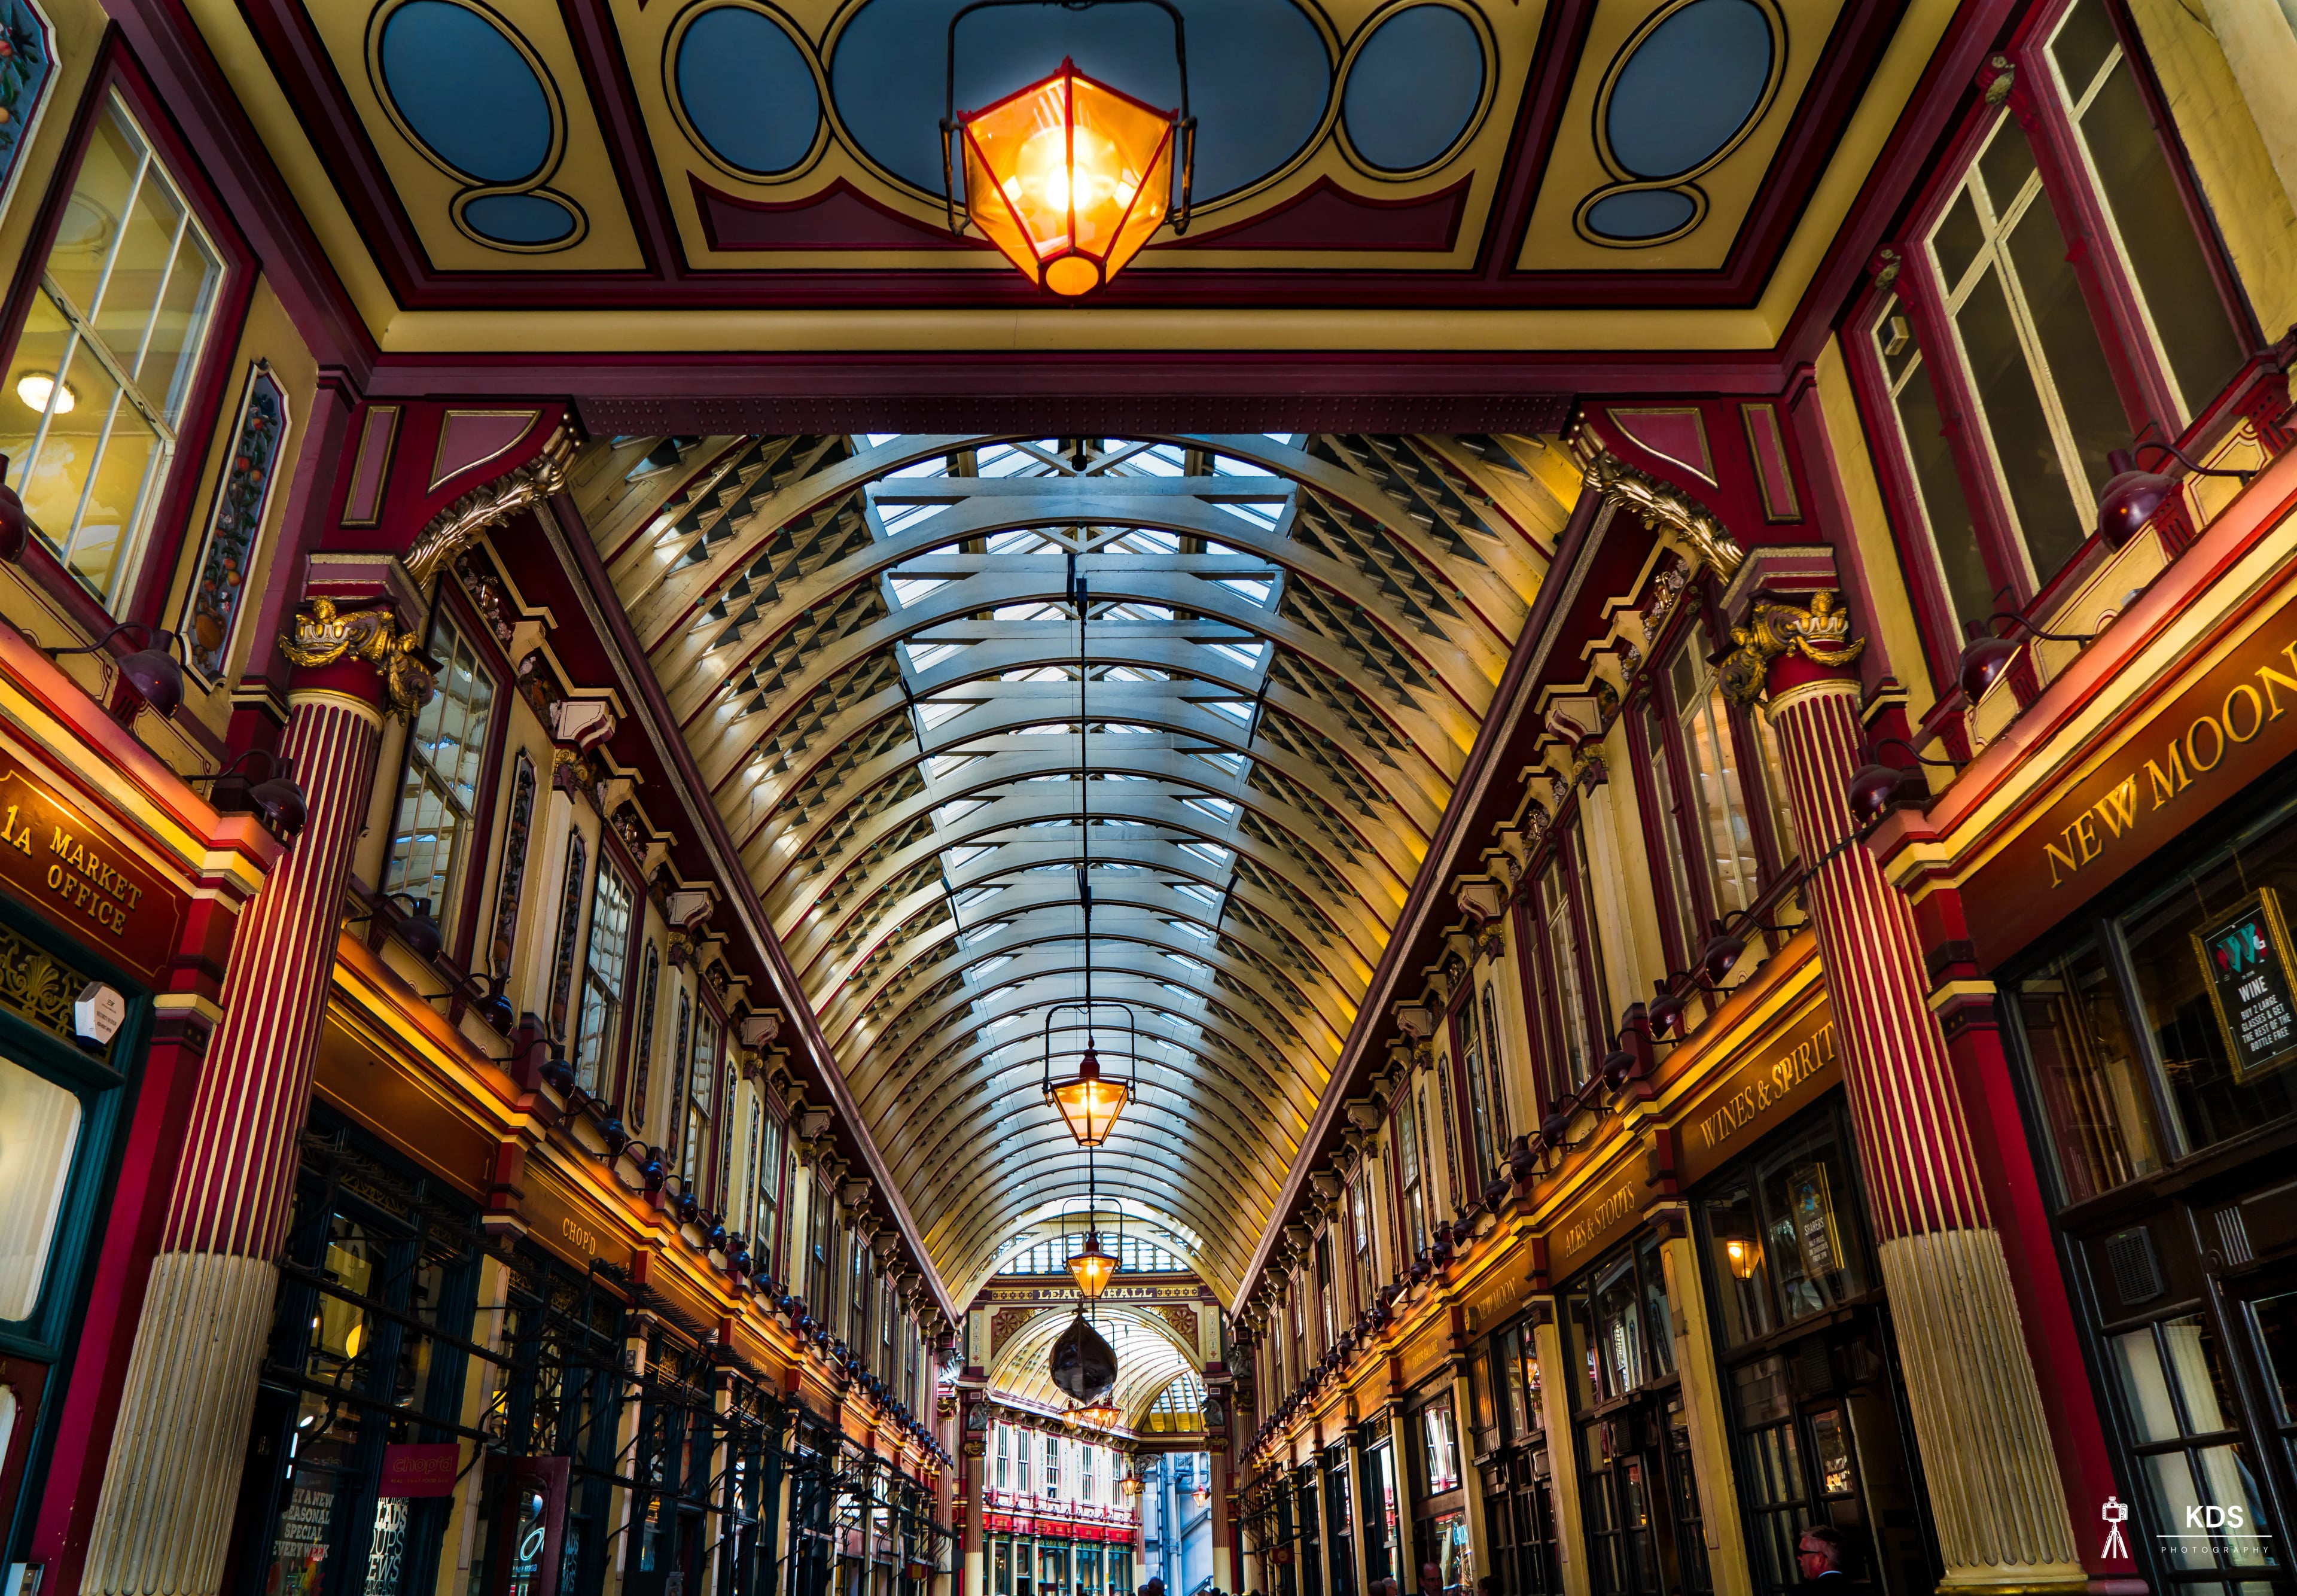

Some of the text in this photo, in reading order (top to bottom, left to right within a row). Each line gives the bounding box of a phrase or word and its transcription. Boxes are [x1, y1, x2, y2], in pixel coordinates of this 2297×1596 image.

[2043, 640, 2297, 889] NEW MOON
[50, 826, 142, 910] MARKET
[48, 865, 126, 936] OFFICE
[2238, 976, 2268, 1003] WINE
[2240, 994, 2278, 1021] BUY 2 LARGE
[2241, 1003, 2285, 1032] GLASSES & GET
[2241, 1013, 2292, 1043] THE REST OF THE
[2250, 1027, 2290, 1052] BOTTLE FREE
[1700, 1086, 1755, 1149] WINES
[1758, 1080, 1772, 1110] &
[1566, 1181, 1634, 1258] ALES & STOUTS
[563, 1217, 596, 1255] CHOP'D
[1038, 1288, 1153, 1300] LEADHALL
[1477, 1277, 1516, 1323] NEW MOON
[393, 1455, 452, 1475] chop'd
[304, 1490, 311, 1505] A
[312, 1491, 334, 1507] NEW
[284, 1523, 322, 1541] SPECIAL
[304, 1543, 330, 1558] WEEK
[367, 1554, 401, 1582] EWS
